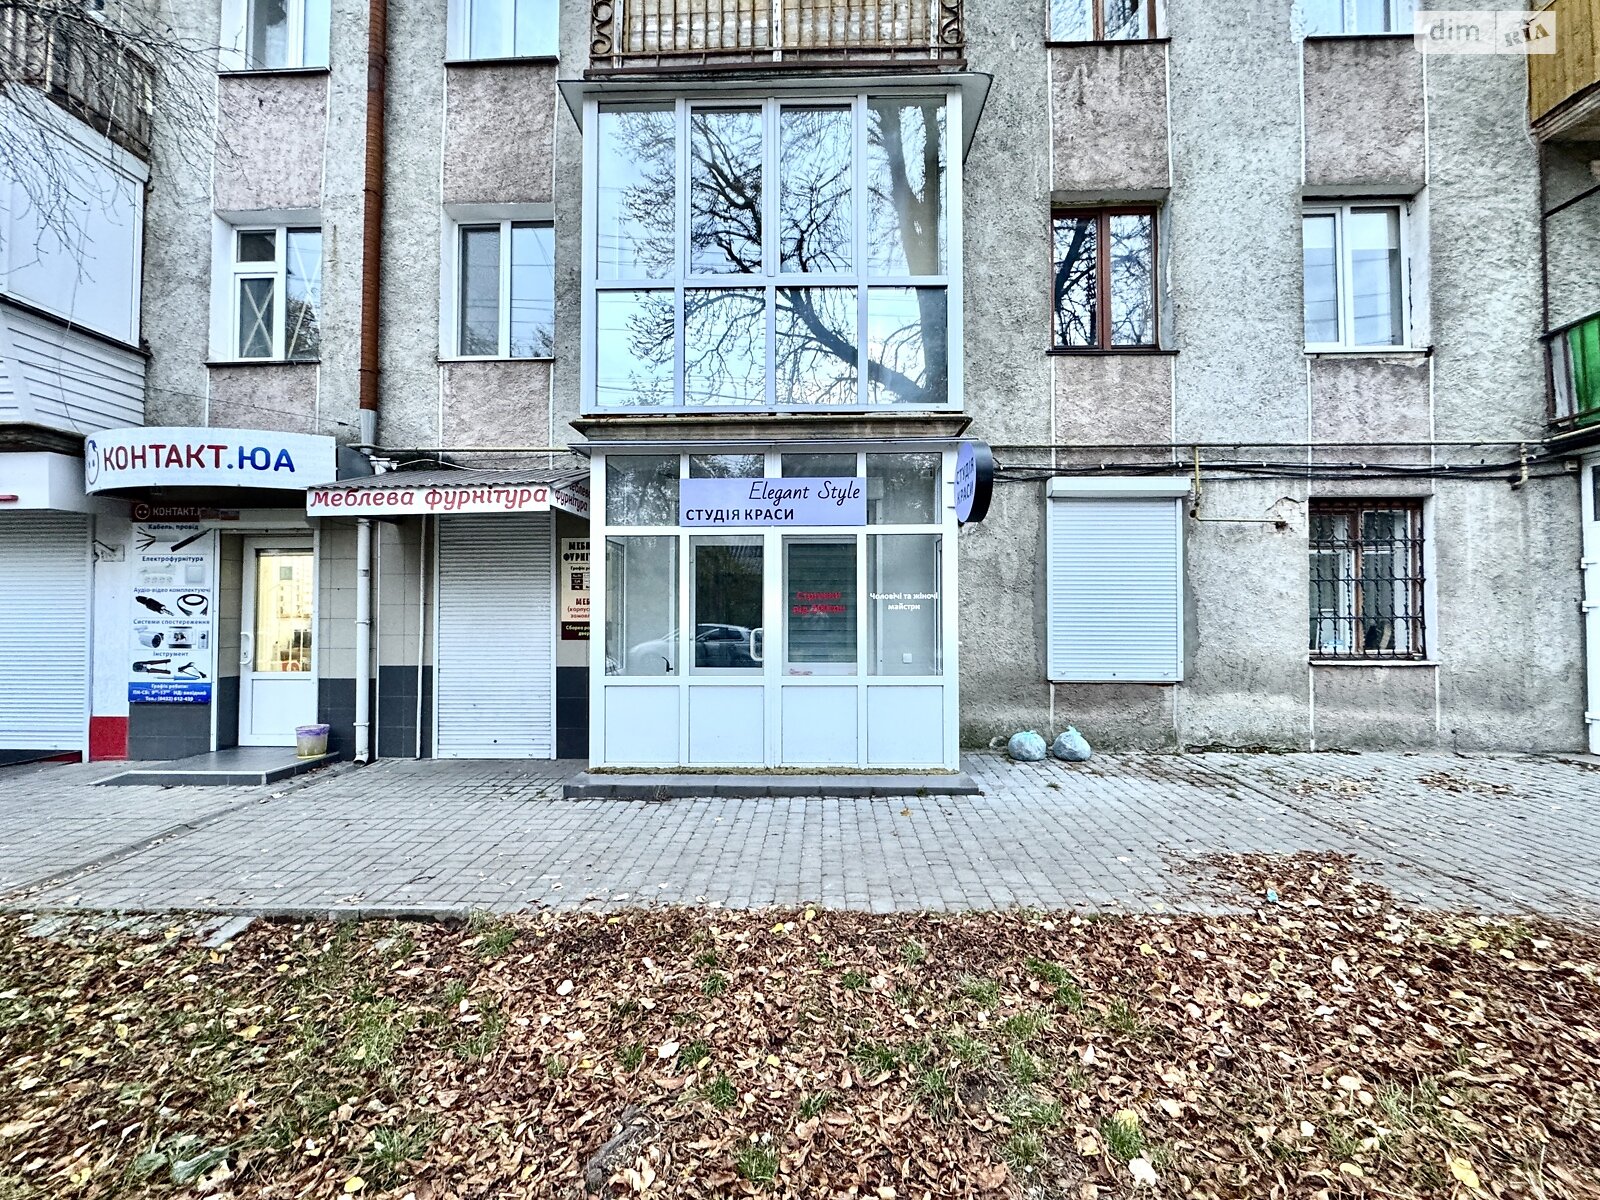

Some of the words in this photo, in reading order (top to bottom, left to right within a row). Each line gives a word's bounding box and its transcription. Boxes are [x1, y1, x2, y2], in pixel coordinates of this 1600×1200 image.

[103, 443, 296, 473] КОНТАКТ.ЮА
[956, 456, 975, 485] СТУДІЯ
[309, 487, 415, 508] Меблева
[424, 485, 548, 511] фурнітура
[554, 489, 588, 513] фурнітура
[748, 480, 810, 506] Elegant
[817, 480, 861, 506] Style
[956, 480, 974, 504] КРАСИ
[685, 508, 740, 523] СТУДІЯ
[744, 508, 795, 521] КРАСИ
[175, 523, 199, 531] провід
[142, 555, 204, 564] Електрофурнітура
[869, 591, 903, 600] Чоловічі
[912, 591, 939, 600] жіночі
[887, 602, 921, 612] майстри
[133, 618, 161, 626] Системи
[161, 618, 210, 626] спостереження
